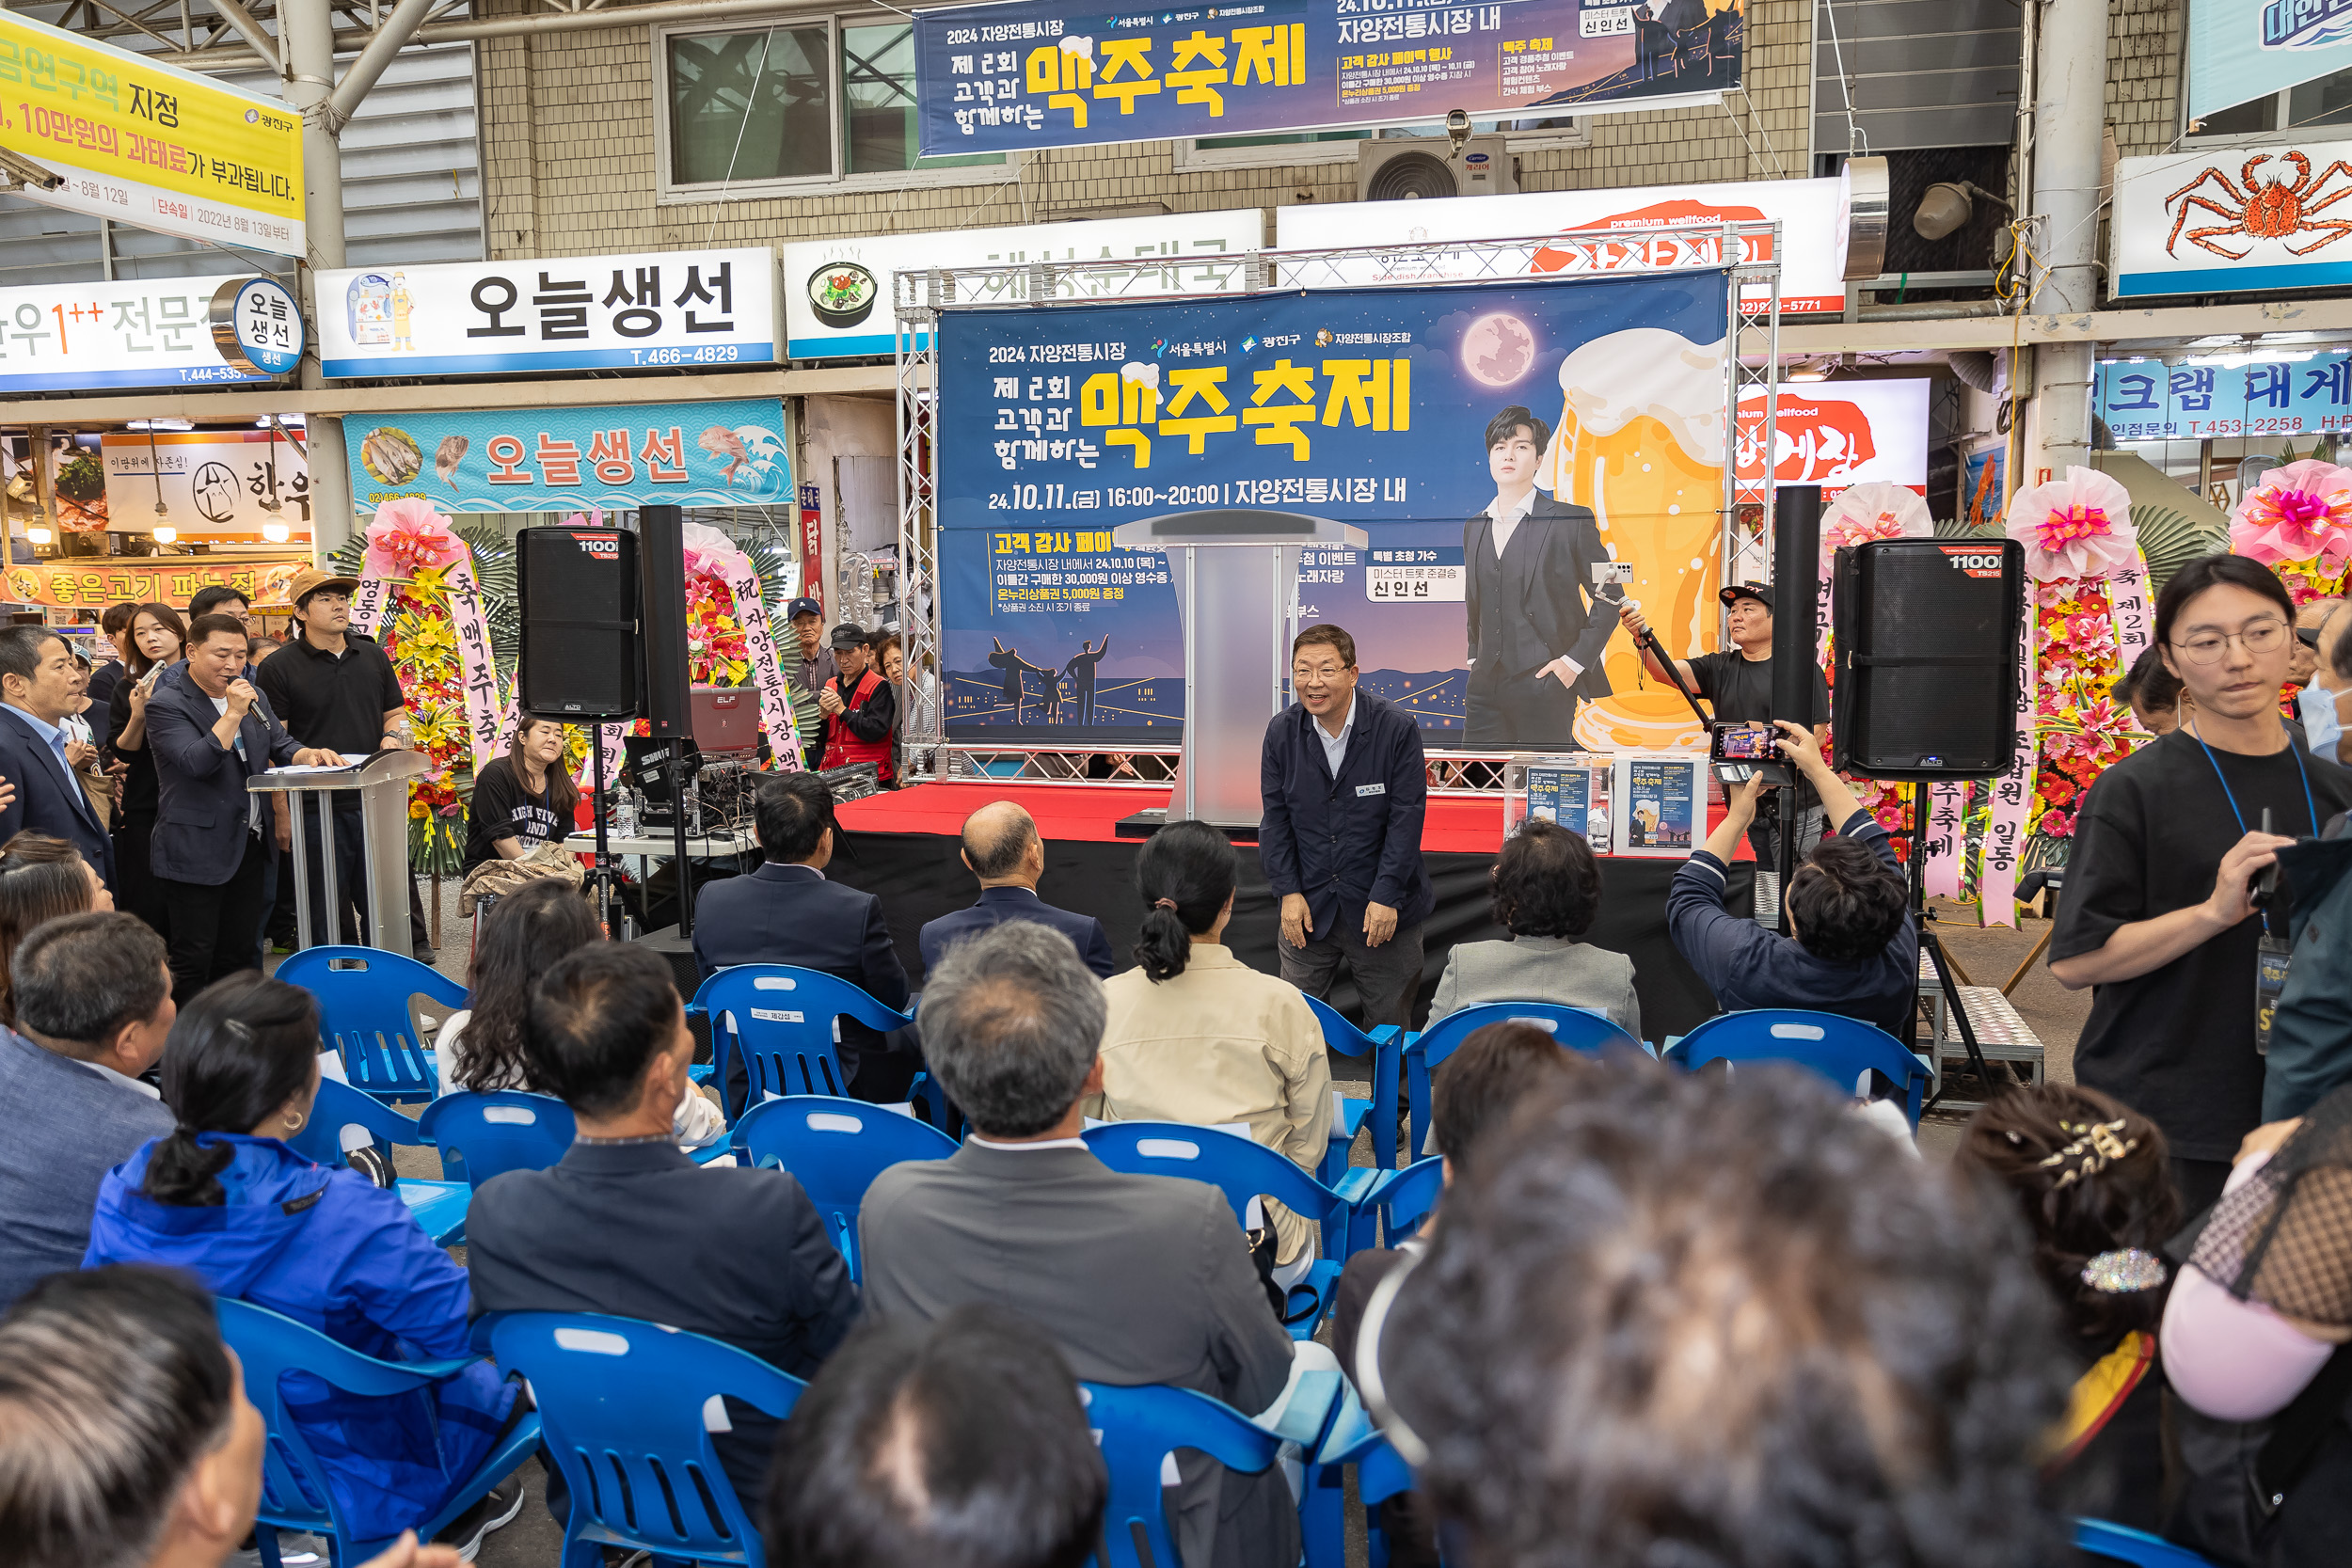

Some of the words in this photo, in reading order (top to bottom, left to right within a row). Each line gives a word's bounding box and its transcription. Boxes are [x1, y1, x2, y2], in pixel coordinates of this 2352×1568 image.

[1338, 8, 1474, 44] 자양전통시장
[1479, 6, 1501, 31] 내
[1584, 9, 1609, 20] 미스터
[946, 28, 978, 45] 2024
[981, 20, 1064, 42] 자양전통시장
[951, 55, 974, 74] 제
[1341, 55, 1364, 70] 고객
[1366, 53, 1390, 67] 감사
[1392, 50, 1426, 66] 페이백
[1429, 47, 1453, 61] 행사
[1502, 56, 1518, 66] 고객
[1551, 51, 1575, 60] 이벤트
[1502, 67, 1518, 75] 고객
[1519, 65, 1535, 74] 참여
[1536, 62, 1567, 72] 노래자랑
[0, 38, 119, 113] 금연구역
[129, 82, 179, 128] 지정
[1384, 76, 1411, 87] 30,000원
[1412, 74, 1426, 84] 이상
[1464, 70, 1471, 78] 시
[954, 78, 1020, 106] 고객과
[1383, 85, 1406, 95] 5,000원
[1502, 87, 1518, 96] 간식
[1536, 85, 1552, 94] 부스
[261, 114, 294, 133] 광진구
[954, 103, 1044, 135] 함께하는
[19, 103, 119, 157] 10만원의
[125, 131, 205, 180] 과태료가
[211, 157, 295, 201] 부과됩니다.
[81, 181, 100, 199] 8월
[103, 186, 128, 205] 12일
[158, 198, 188, 219] 단속일
[197, 208, 231, 229] 2022년
[234, 216, 249, 232] 8월
[252, 221, 290, 241] 13일부터
[1610, 216, 1663, 229] premium
[1668, 214, 1721, 225] wellfood
[250, 293, 288, 322] 오늘
[467, 261, 734, 340] 오늘생선
[0, 302, 103, 359] 우1++
[250, 319, 290, 348] 생선
[1262, 334, 1301, 348] 광진구
[1335, 332, 1411, 344] 자양전통시장조합
[262, 351, 282, 366] 생선
[630, 345, 739, 366] T.466-4829
[989, 346, 1026, 363] 2024
[1029, 341, 1126, 363] 자양전통시장
[1168, 340, 1227, 357] 서울특별시
[993, 377, 1019, 399] 제
[1028, 376, 1071, 401] 2회
[2091, 365, 2216, 412] 크랩
[2244, 360, 2352, 409] 대게
[994, 407, 1073, 438] 고객과
[2188, 416, 2303, 435] T.453-2258
[486, 425, 689, 486] 오늘생선
[993, 438, 1100, 470] 함께하는
[1107, 484, 1219, 508] 16:00~20:00
[1235, 478, 1377, 505] 자양전통시장
[1384, 477, 1407, 503] 내
[994, 532, 1031, 554] 고객
[1035, 532, 1072, 553] 감사
[995, 559, 1058, 572] 자양전통시장
[1061, 558, 1093, 571] 내에서
[1095, 558, 1134, 570] 24.10.10
[1136, 557, 1155, 570] (목)
[1319, 551, 1357, 566] 이벤트
[1373, 551, 1392, 562] 특별
[1395, 551, 1415, 562] 초청
[1417, 550, 1438, 562] 가수
[1949, 555, 1999, 569] 1100
[997, 575, 1029, 586] 이틀간
[1030, 574, 1063, 586] 구매한
[1065, 573, 1108, 586] 30,000원
[1111, 573, 1133, 585] 이상
[1135, 572, 1168, 585] 영수증
[1374, 569, 1403, 579] 미스터
[1405, 569, 1424, 579] 트롯
[1427, 568, 1457, 579] 준결승
[2112, 568, 2141, 586] 축
[50, 571, 161, 603] 좋은고기
[735, 578, 760, 602] 祝
[997, 588, 1060, 601] 온누리상품권
[1063, 588, 1100, 600] 5,000원
[1103, 588, 1124, 599] 증정
[1028, 602, 1044, 612] 소진
[1046, 602, 1055, 612] 시
[1057, 602, 1073, 612] 조기
[1073, 602, 1091, 612] 종료
[2116, 595, 2147, 648] 제2회
[745, 608, 794, 741] 자양전통시장
[536, 807, 559, 827] FIVE
[1986, 821, 2017, 871] 일동
